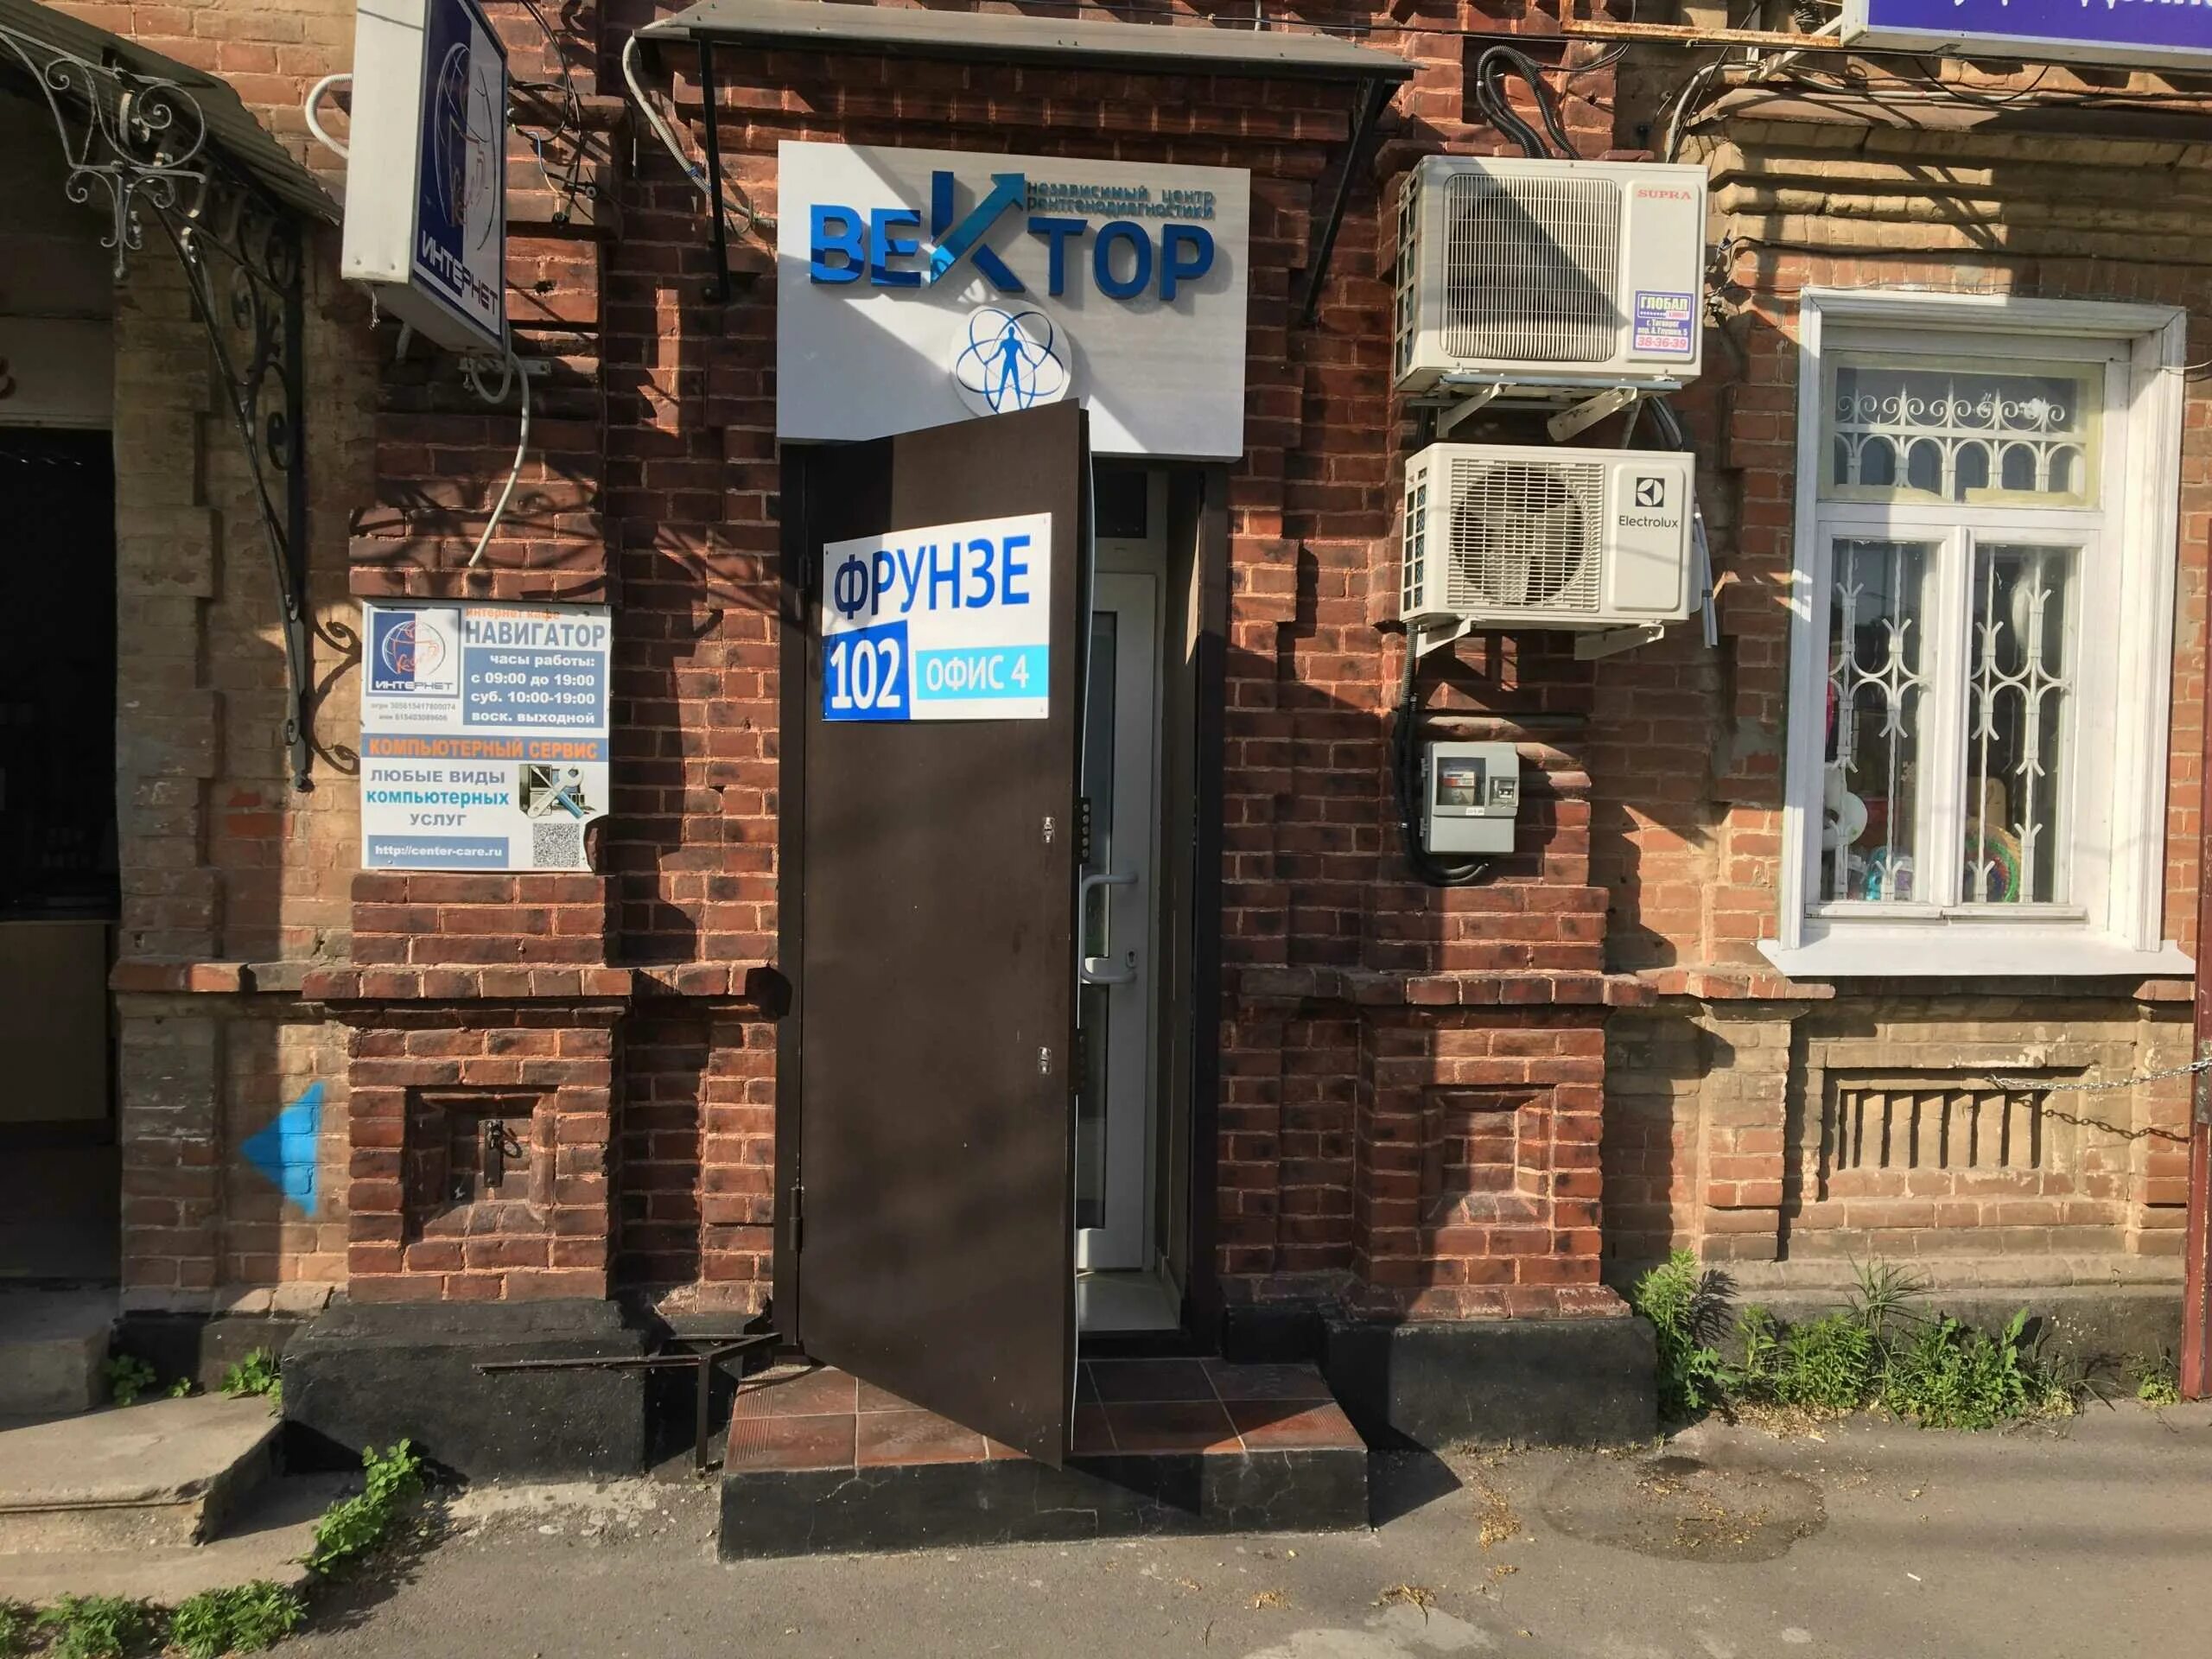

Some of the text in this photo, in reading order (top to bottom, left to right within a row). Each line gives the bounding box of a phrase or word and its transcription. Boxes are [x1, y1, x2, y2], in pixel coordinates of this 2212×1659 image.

[1637, 188, 1692, 200] SUPRA
[810, 170, 1215, 301] ВЕКТОР
[423, 230, 498, 315] ИНТЕРНЕТ
[1640, 296, 1688, 310] ГЛОБАЛ
[1637, 336, 1688, 349] 38-36-39
[1618, 515, 1679, 528] Electrolux
[834, 535, 1031, 620] ФРУНЗЕ
[465, 620, 605, 647] НАВИГАТОР
[490, 654, 595, 668] часы работы:
[485, 672, 526, 684] 09:00
[530, 674, 550, 687] до
[554, 674, 594, 686] 19:00
[830, 638, 900, 709] 102
[925, 654, 1030, 691] ОФИС 4
[375, 680, 454, 690] ИНТЕРНЕТ
[471, 691, 595, 704] суб. 10:00-19:00
[472, 711, 594, 725] воск. выходной
[369, 738, 598, 759] КОМПЬЮТЕРНЫЙ СЕРВИС
[370, 769, 505, 785] ЛЮБЫЕ ВИДЫ
[366, 791, 509, 808] компьютерных
[410, 814, 467, 826] УСЛУГ
[375, 845, 503, 857] http://center-care.ru
